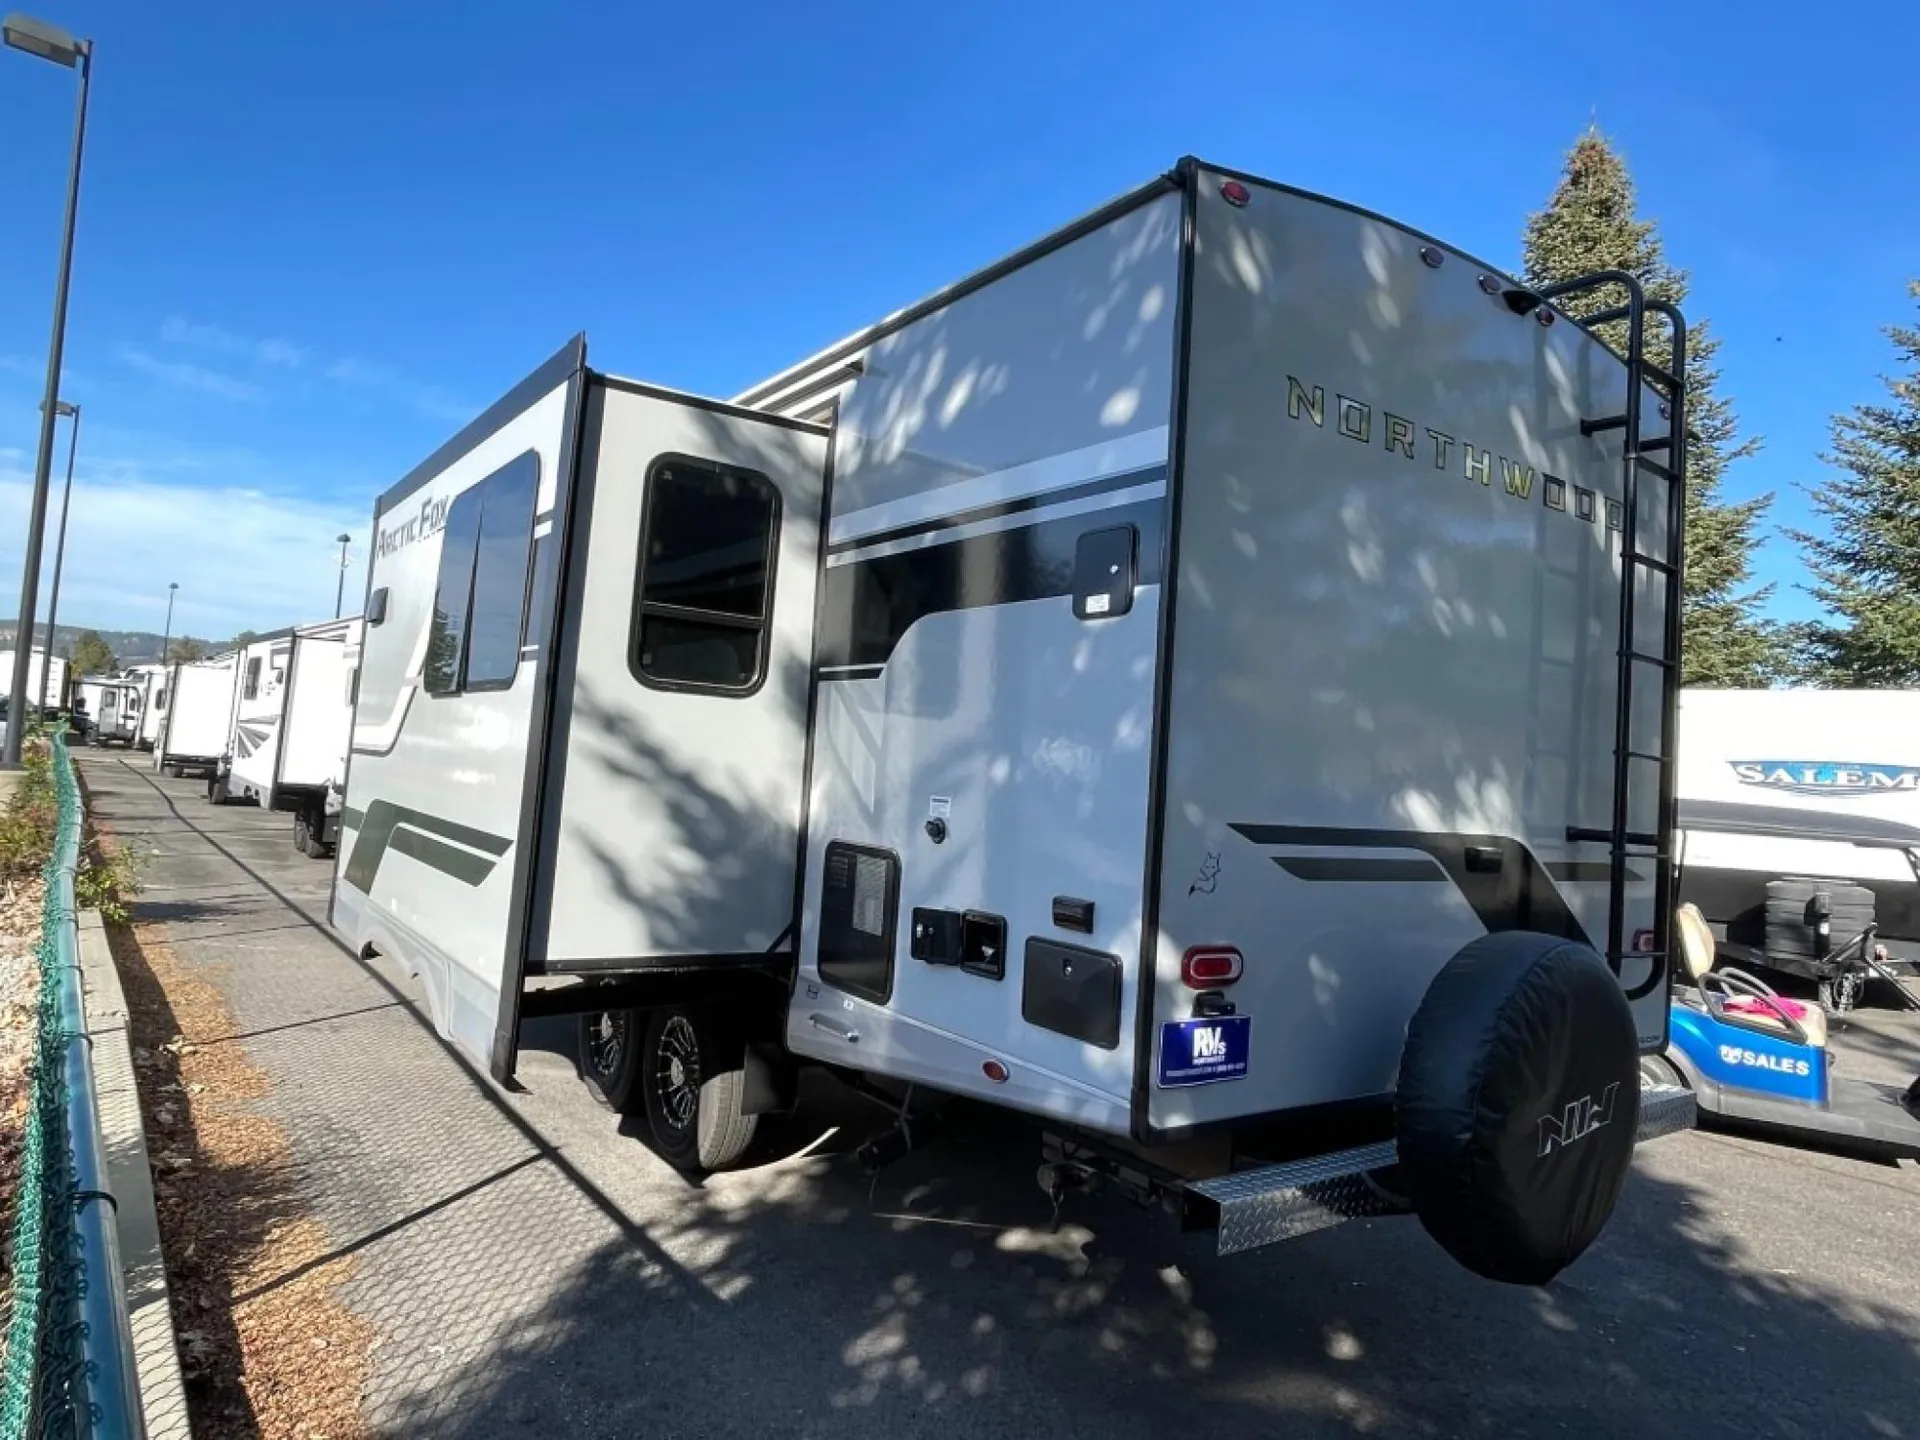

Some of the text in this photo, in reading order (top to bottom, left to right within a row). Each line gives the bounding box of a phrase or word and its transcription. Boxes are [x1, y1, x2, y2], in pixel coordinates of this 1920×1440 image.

[1286, 374, 1624, 533] NORTHWOOD
[1735, 764, 1919, 788] SALEM
[1742, 1051, 1810, 1076] SALES
